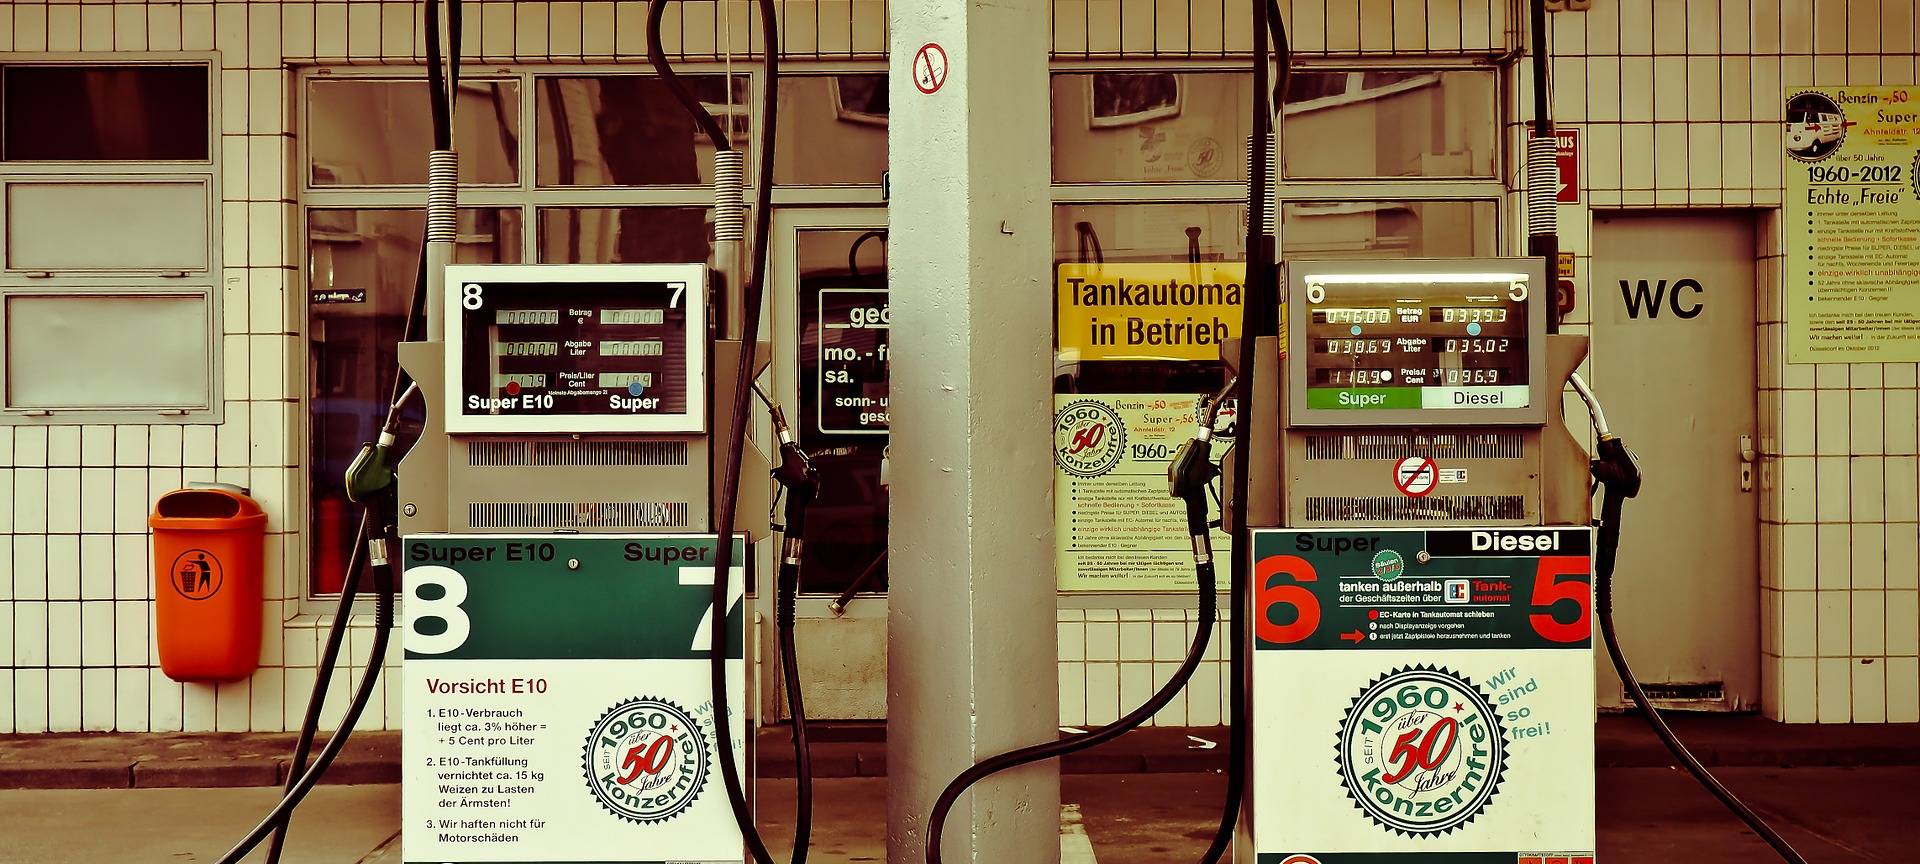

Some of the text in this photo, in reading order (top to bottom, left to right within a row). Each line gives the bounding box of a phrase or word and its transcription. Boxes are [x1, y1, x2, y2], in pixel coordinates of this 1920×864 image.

[1838, 91, 1878, 104] Benzin
[1877, 110, 1917, 124] Super
[1808, 165, 1901, 182] 1960-2012
[1808, 187, 1849, 204] Echte
[463, 284, 483, 310] 8
[666, 283, 685, 308] 7
[1067, 278, 1246, 306] Tankautoma
[1306, 282, 1326, 304] 6
[1508, 281, 1528, 302] 5
[1618, 278, 1704, 320] WC
[1396, 308, 1423, 316] Betrag
[1402, 315, 1419, 323] EUR
[1091, 317, 1229, 345] in Betrieb
[1396, 338, 1426, 346] Abgabe
[1404, 345, 1422, 353] Liter
[824, 347, 862, 361] mo.
[568, 380, 586, 388] Cent
[825, 370, 854, 384] sa.
[1406, 376, 1424, 384] Cent
[468, 395, 554, 413] Super E10
[609, 395, 660, 413] Super
[836, 397, 876, 408] sonn-
[1115, 400, 1144, 410] Benzin
[1338, 392, 1387, 408] Super
[1454, 391, 1504, 404] Diesel
[1060, 408, 1100, 432] 1960
[1144, 414, 1172, 424] Super
[1068, 422, 1105, 454] 50
[1131, 444, 1184, 458] 1960-
[1296, 534, 1380, 556] Super
[1472, 531, 1560, 550] Diesel
[410, 543, 556, 566] Super E10
[624, 542, 709, 566] Super
[1339, 580, 1442, 592] tanken außerhalb
[1472, 580, 1512, 592] Tank-
[1254, 555, 1321, 644] 6
[1339, 594, 1442, 602] der Geschäftszeiten über
[1529, 556, 1592, 643] 5
[404, 565, 470, 654] 8
[678, 566, 744, 651] 7
[1464, 610, 1494, 618] schieben
[426, 678, 547, 694] Vorsicht E10
[1486, 666, 1516, 691] Wir
[1498, 678, 1538, 706] sind
[427, 708, 436, 718] 1.
[1361, 685, 1450, 736] 1960
[1507, 706, 1532, 722] so
[438, 722, 462, 734] liegt
[465, 723, 481, 732] ca.
[484, 722, 502, 732] 3%
[504, 722, 538, 732] höher
[1398, 710, 1428, 732] über
[601, 711, 668, 750] 1960
[1511, 722, 1551, 740] frei!
[448, 736, 456, 746] 5
[458, 736, 484, 746] Cent
[488, 738, 506, 748] pro
[510, 736, 535, 746] Liter
[1382, 716, 1460, 784] 50
[1364, 738, 1374, 764] SEIT
[426, 758, 436, 766] 2.
[603, 750, 611, 770] SEIT
[616, 734, 674, 786] 50
[1361, 713, 1488, 818] konzernfrei
[438, 771, 544, 782] vernichtet ca. 15 kg
[600, 732, 696, 809] konzernfrei
[438, 784, 535, 794] Weizen zu Lasten
[636, 769, 673, 796] Jahre
[1408, 766, 1456, 800] Jahre
[438, 796, 511, 808] der Ärmsten!
[426, 819, 546, 829] 3. Wir haften nicht für
[438, 832, 519, 842] Motorschäden
